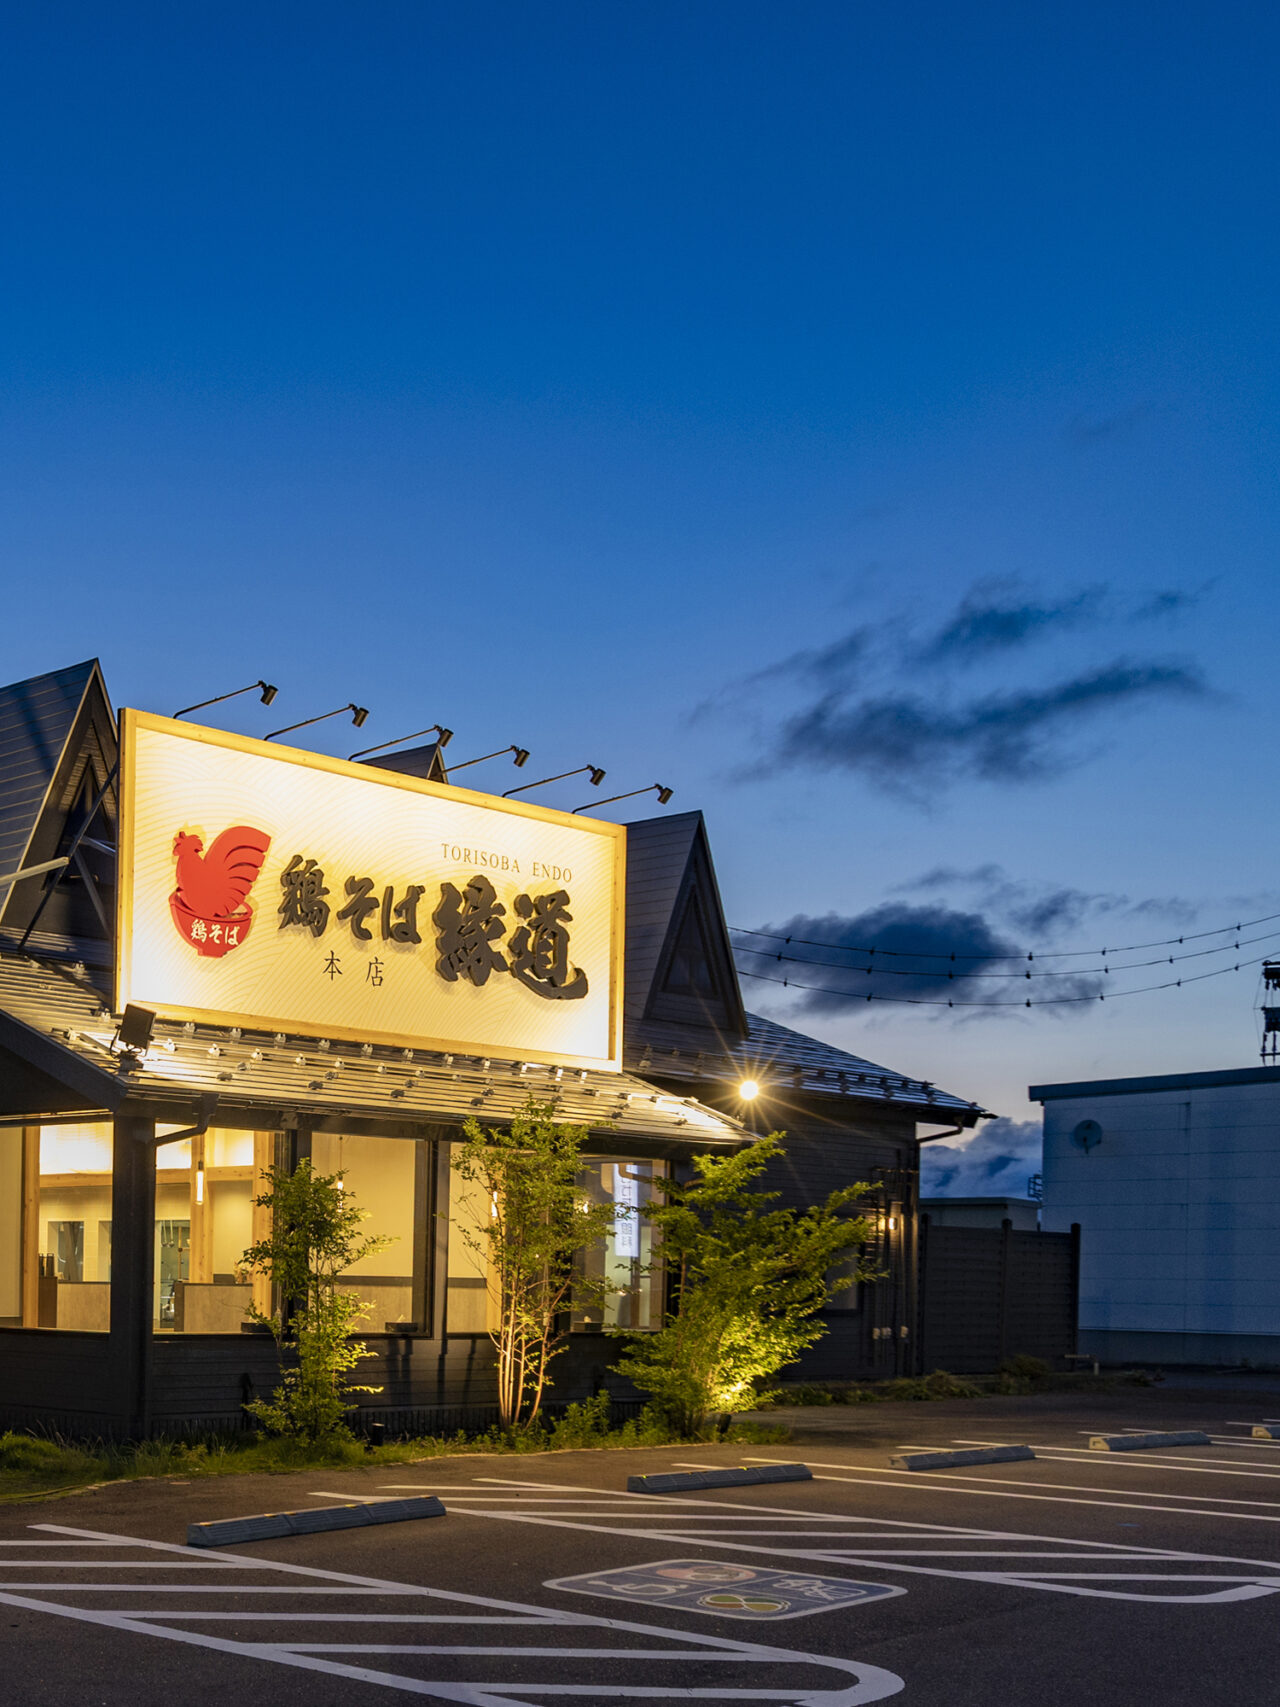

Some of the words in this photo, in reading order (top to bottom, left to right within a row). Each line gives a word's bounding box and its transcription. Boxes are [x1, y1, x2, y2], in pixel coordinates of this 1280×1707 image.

[441, 843, 520, 873] TORISOBA
[532, 861, 572, 883] ENDO
[190, 918, 241, 946] 鶏そば
[322, 950, 385, 987] 本店
